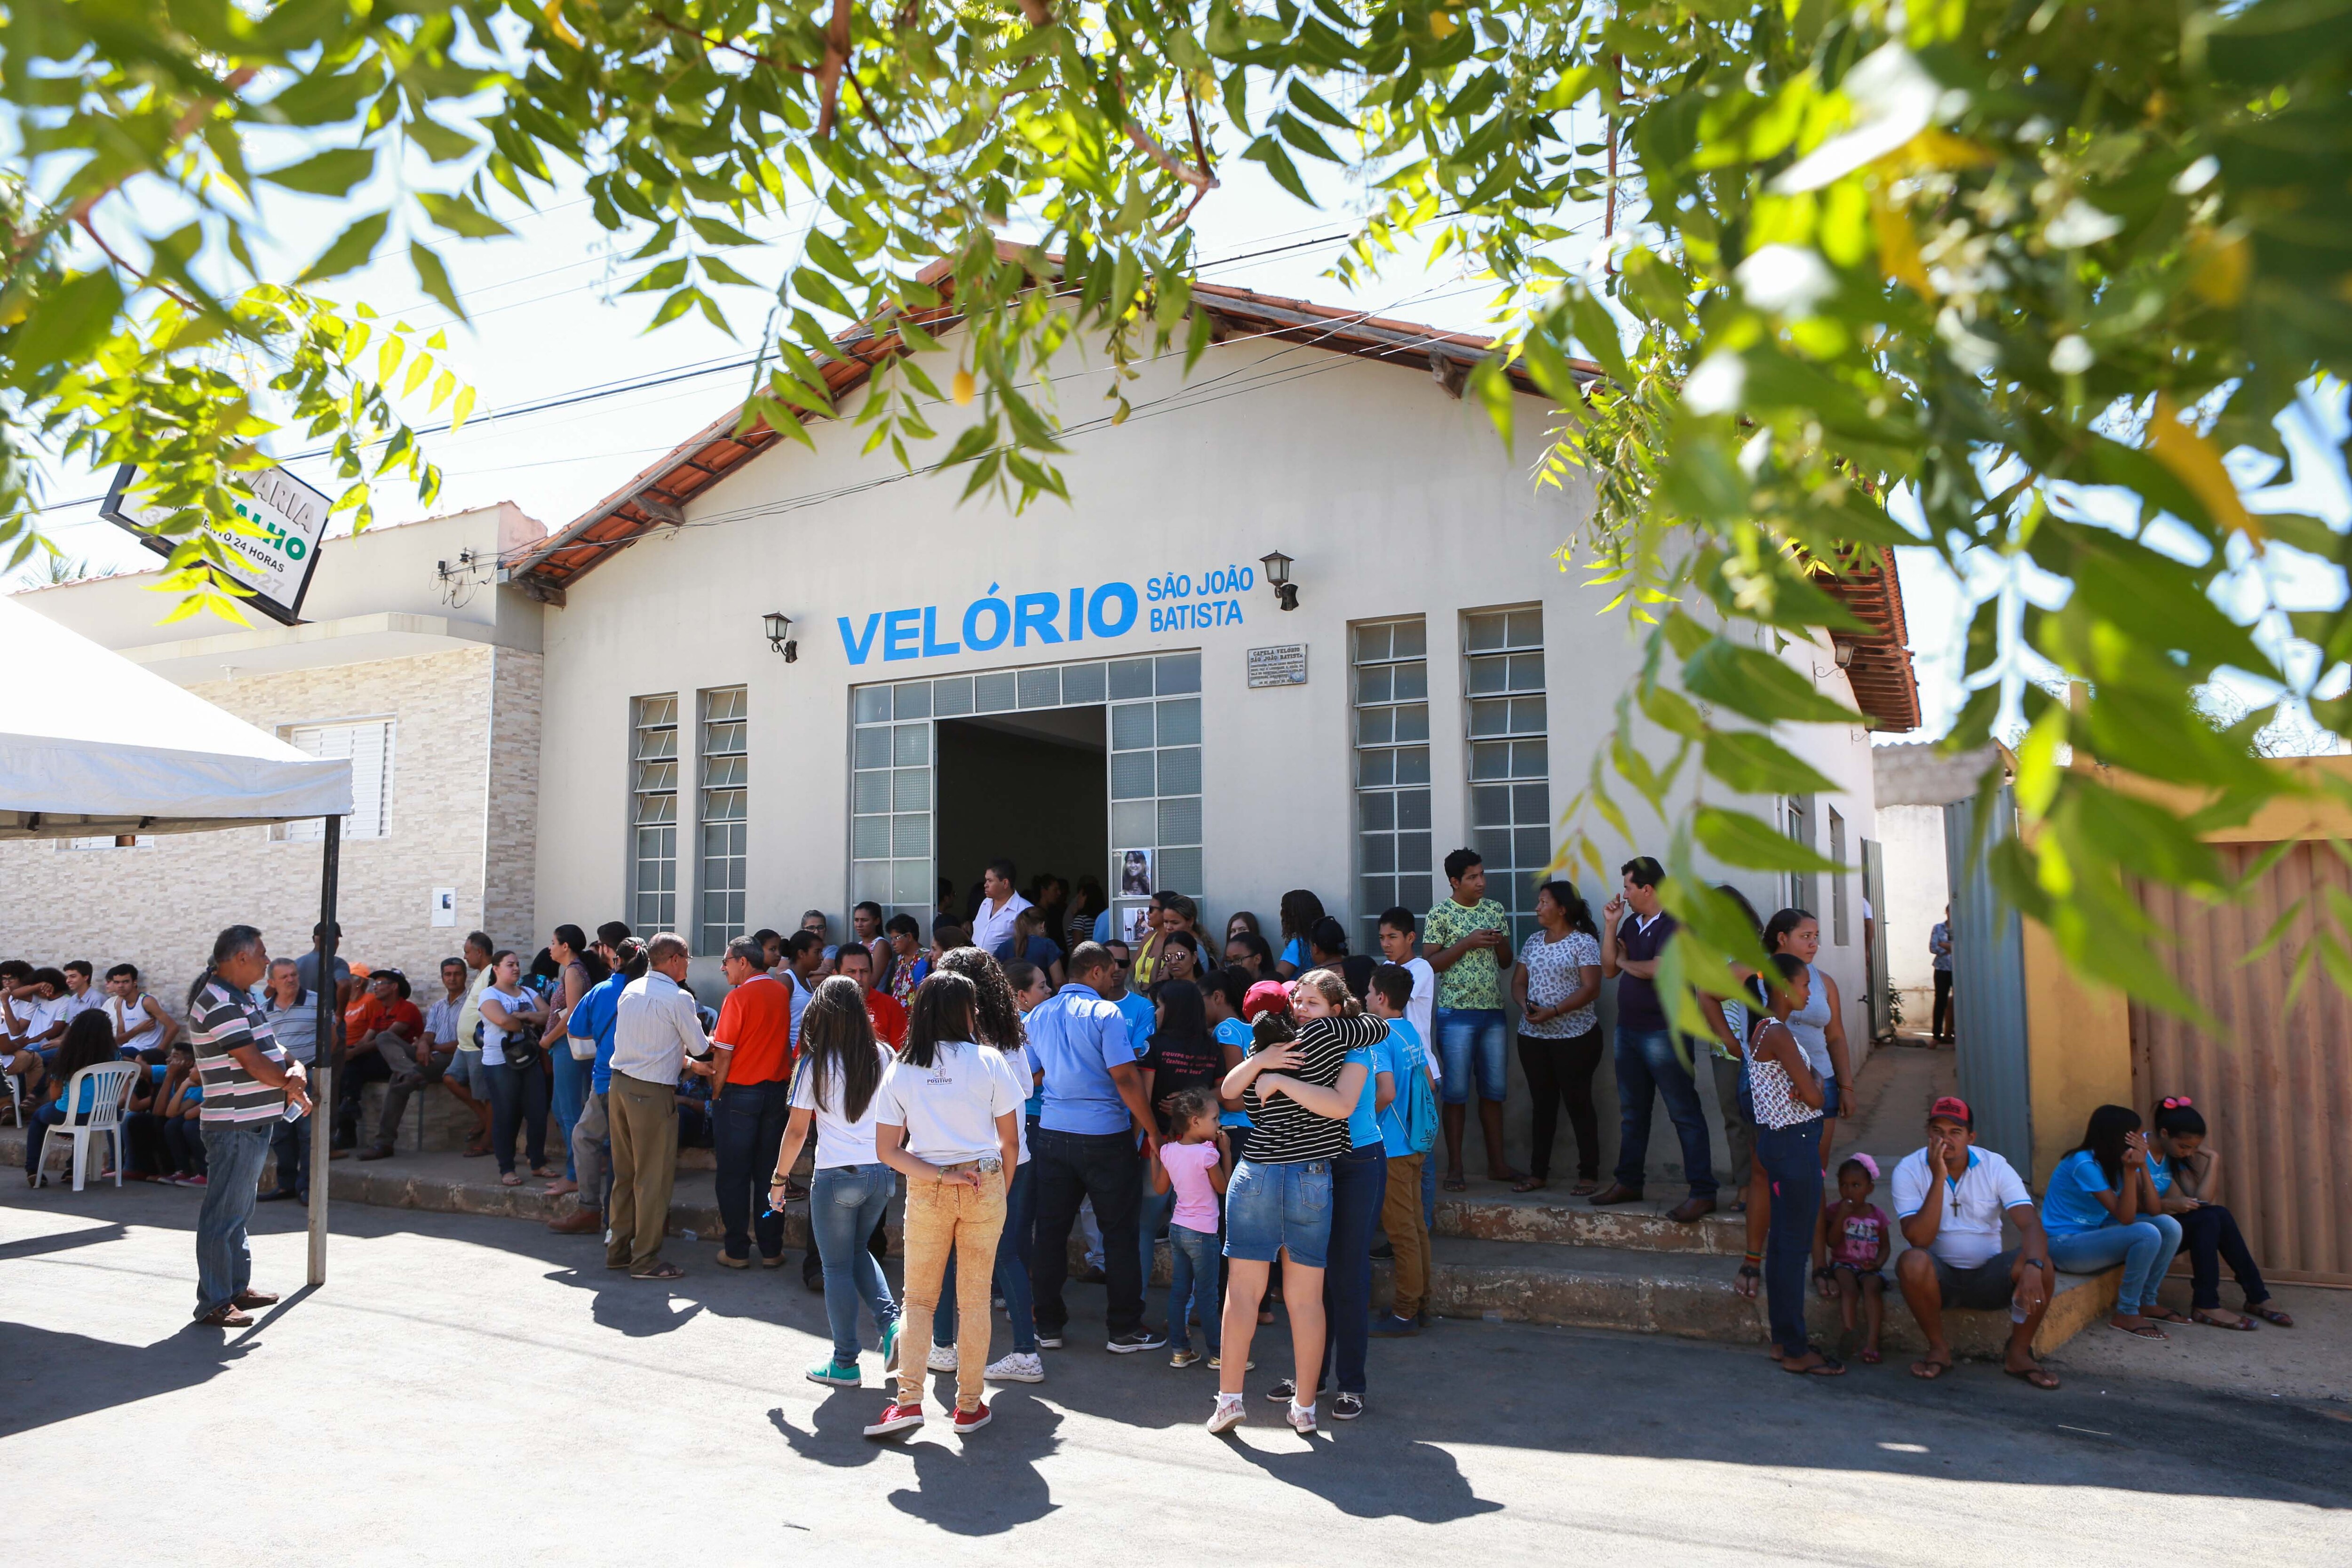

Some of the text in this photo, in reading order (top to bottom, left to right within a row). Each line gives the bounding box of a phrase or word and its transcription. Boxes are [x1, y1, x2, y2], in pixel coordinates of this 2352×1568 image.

[233, 538, 247, 550] 24
[249, 547, 285, 573] HORAS
[1147, 565, 1254, 601] SÃO JOÃO
[837, 581, 1138, 665] VELÓRIO
[1150, 600, 1243, 632] BATISTA
